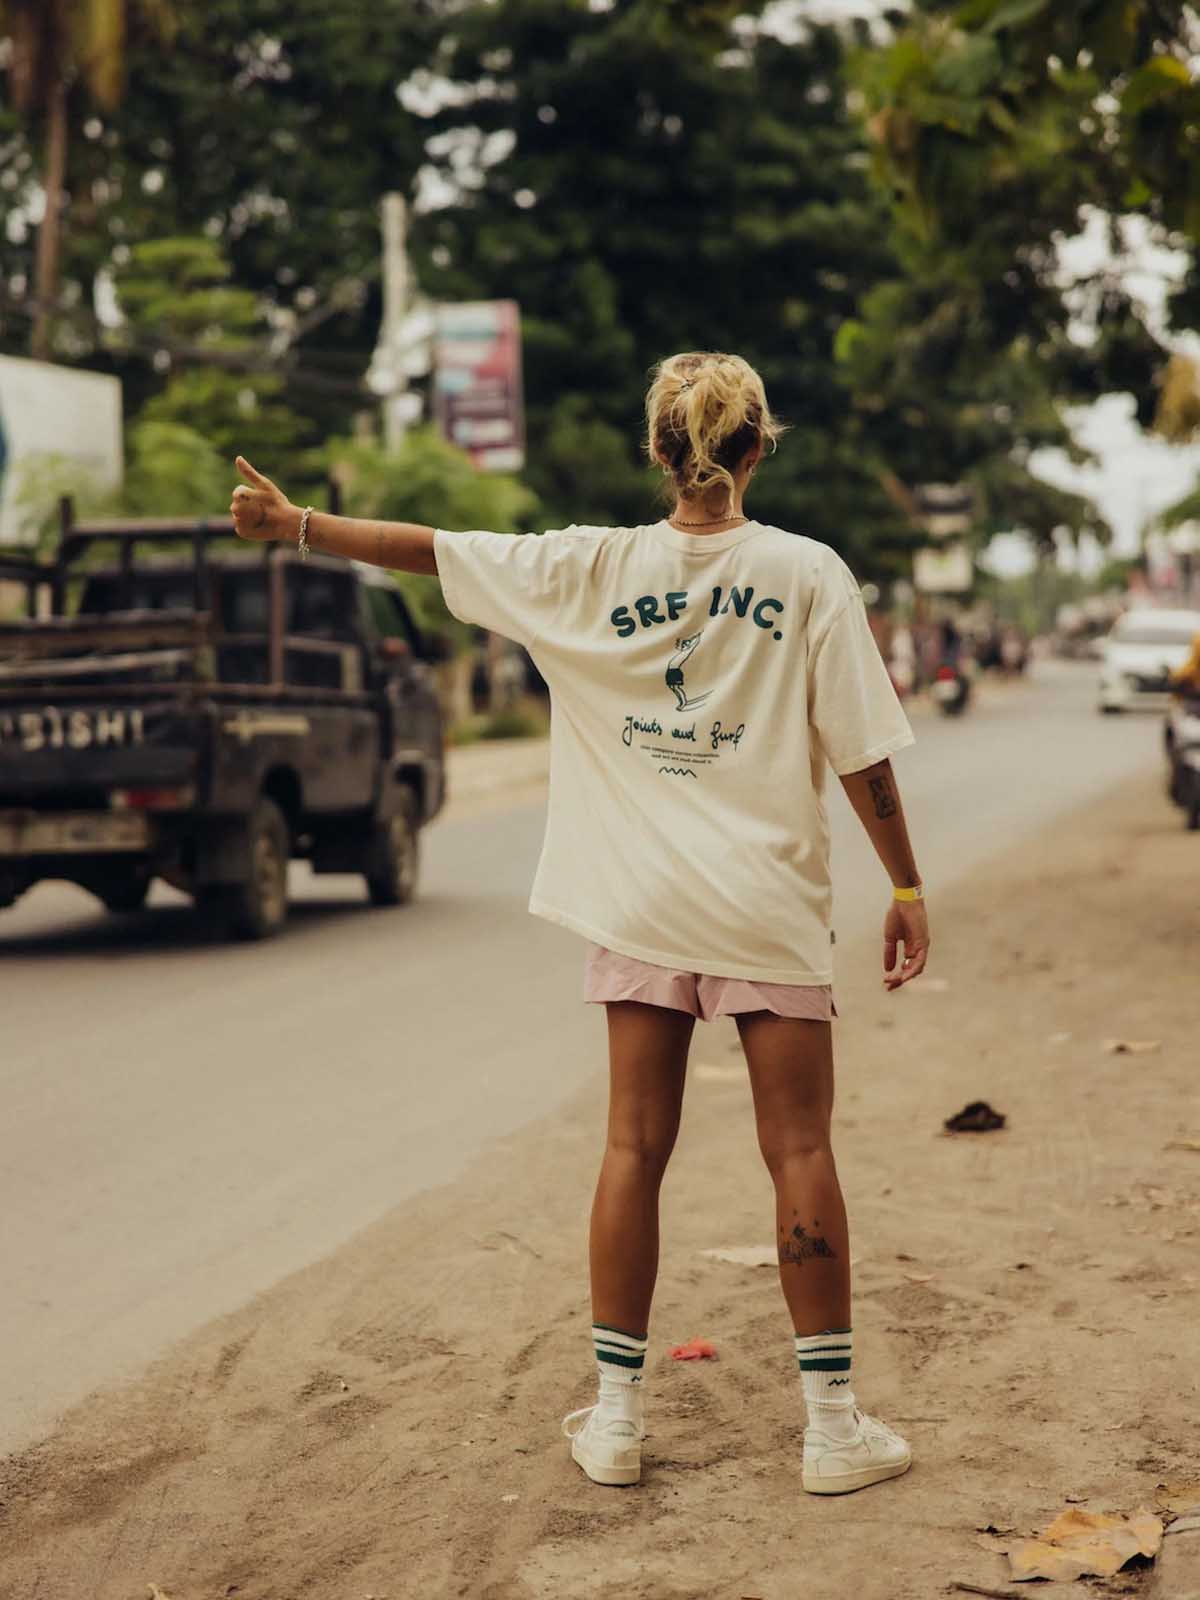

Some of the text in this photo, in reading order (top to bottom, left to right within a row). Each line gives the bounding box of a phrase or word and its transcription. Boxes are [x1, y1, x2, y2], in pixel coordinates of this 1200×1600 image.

[610, 585, 784, 641] SRF INC.
[622, 715, 663, 747] Joints
[671, 722, 697, 742] and
